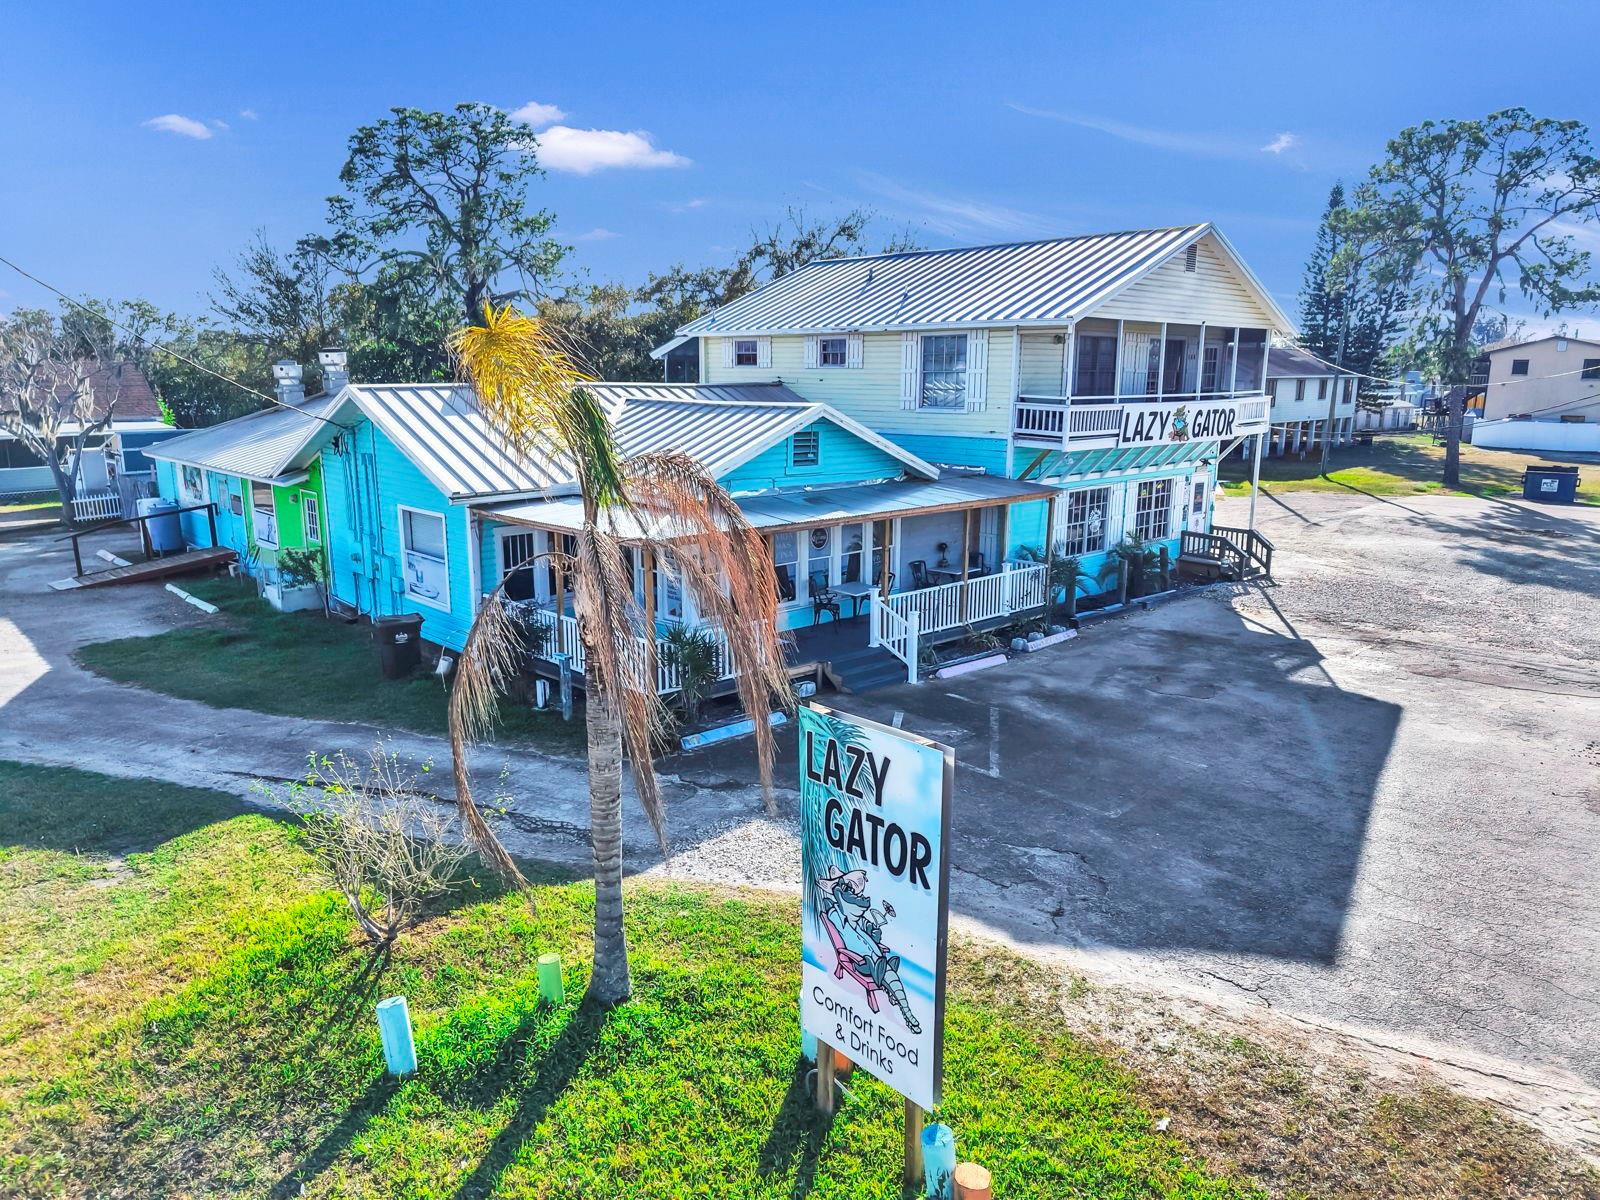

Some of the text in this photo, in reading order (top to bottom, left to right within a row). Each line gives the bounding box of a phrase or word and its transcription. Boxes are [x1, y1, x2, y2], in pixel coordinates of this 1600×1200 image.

[1122, 408, 1236, 443] LAZY GATOR
[806, 731, 891, 806] LAZY
[825, 798, 932, 890] GATOR
[813, 986, 919, 1067] Comfort Food
[835, 1023, 893, 1074] & Drinks
